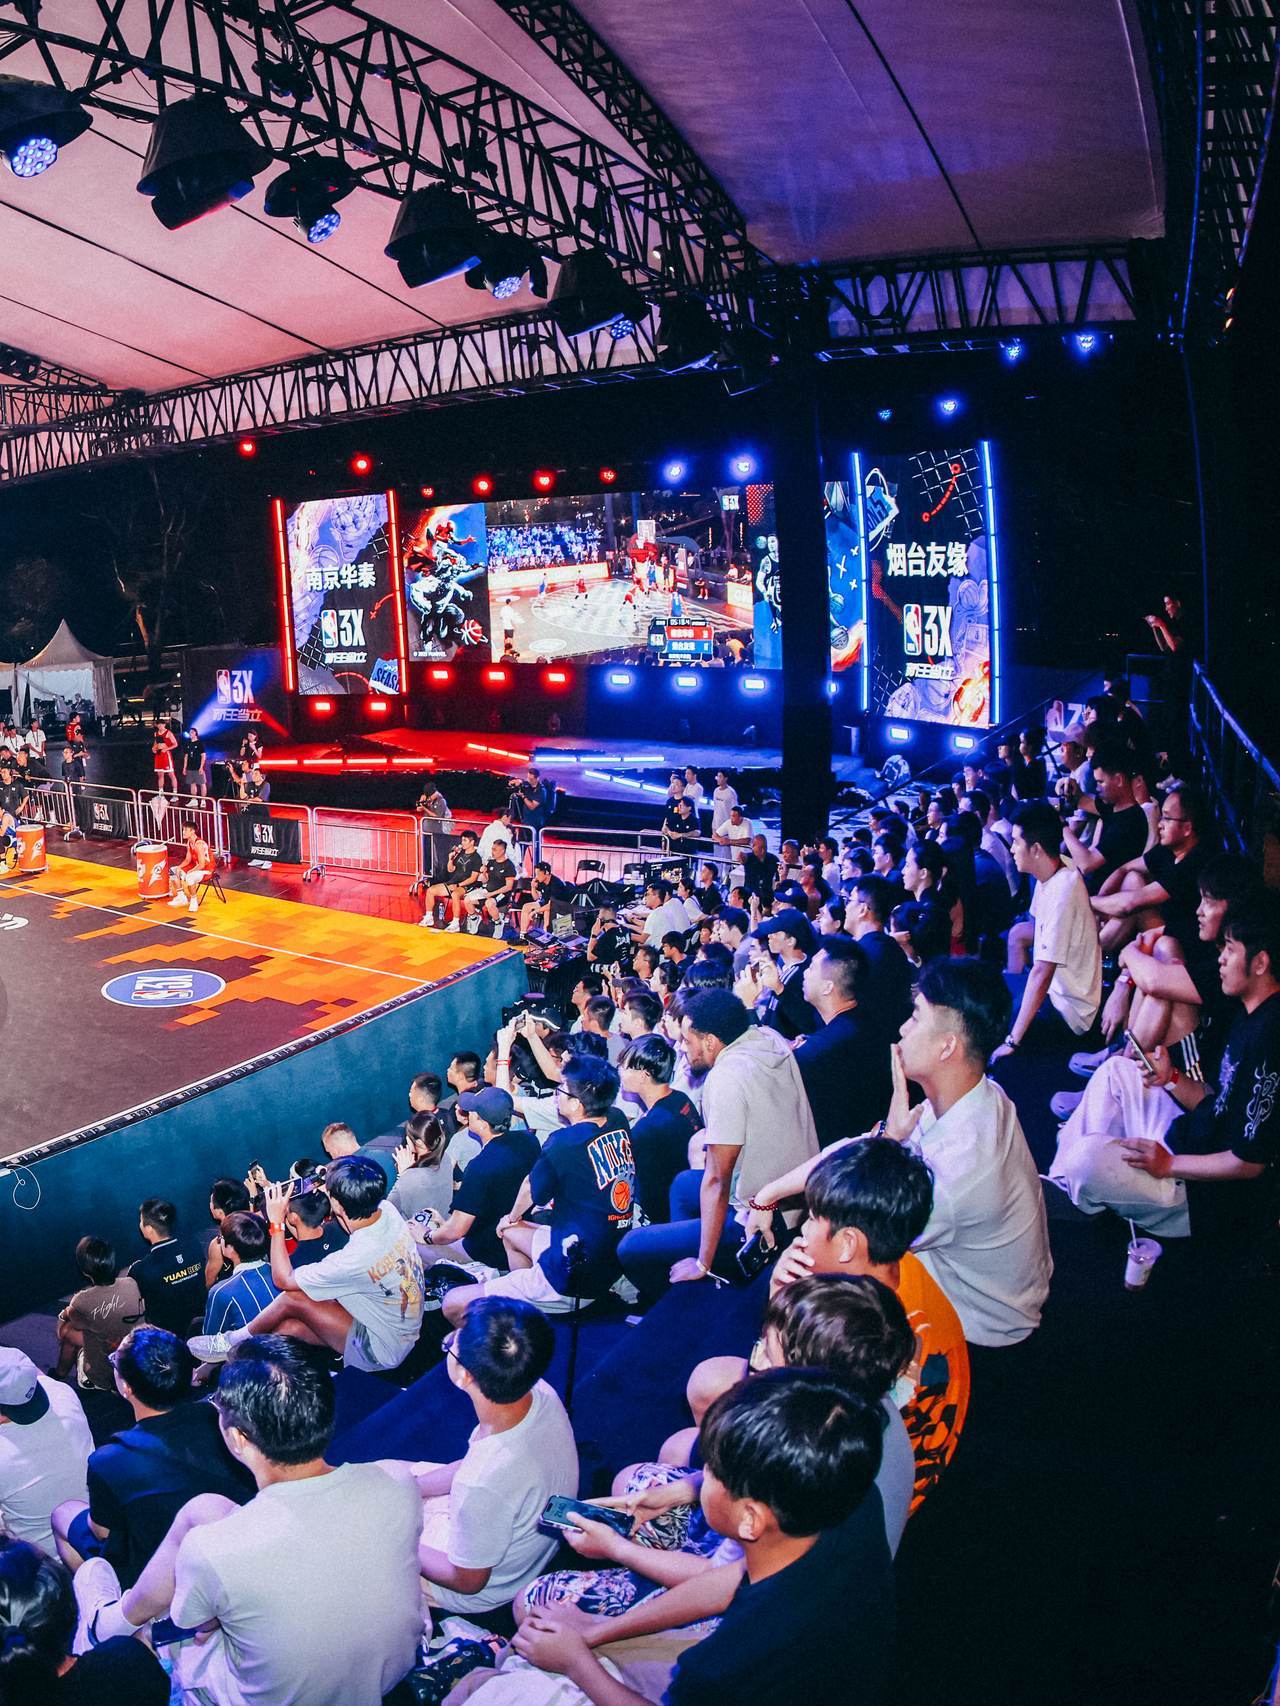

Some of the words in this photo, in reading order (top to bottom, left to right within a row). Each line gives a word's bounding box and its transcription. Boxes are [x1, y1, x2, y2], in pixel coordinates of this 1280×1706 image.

[886, 542, 969, 577] 烟台友缘
[306, 562, 376, 590] 南京华泰
[339, 609, 366, 647] 3X
[924, 605, 953, 657] 3X
[231, 670, 255, 704] 3X
[261, 824, 274, 844] 3X
[134, 974, 193, 990] 3X
[163, 1269, 188, 1283] YUAN
